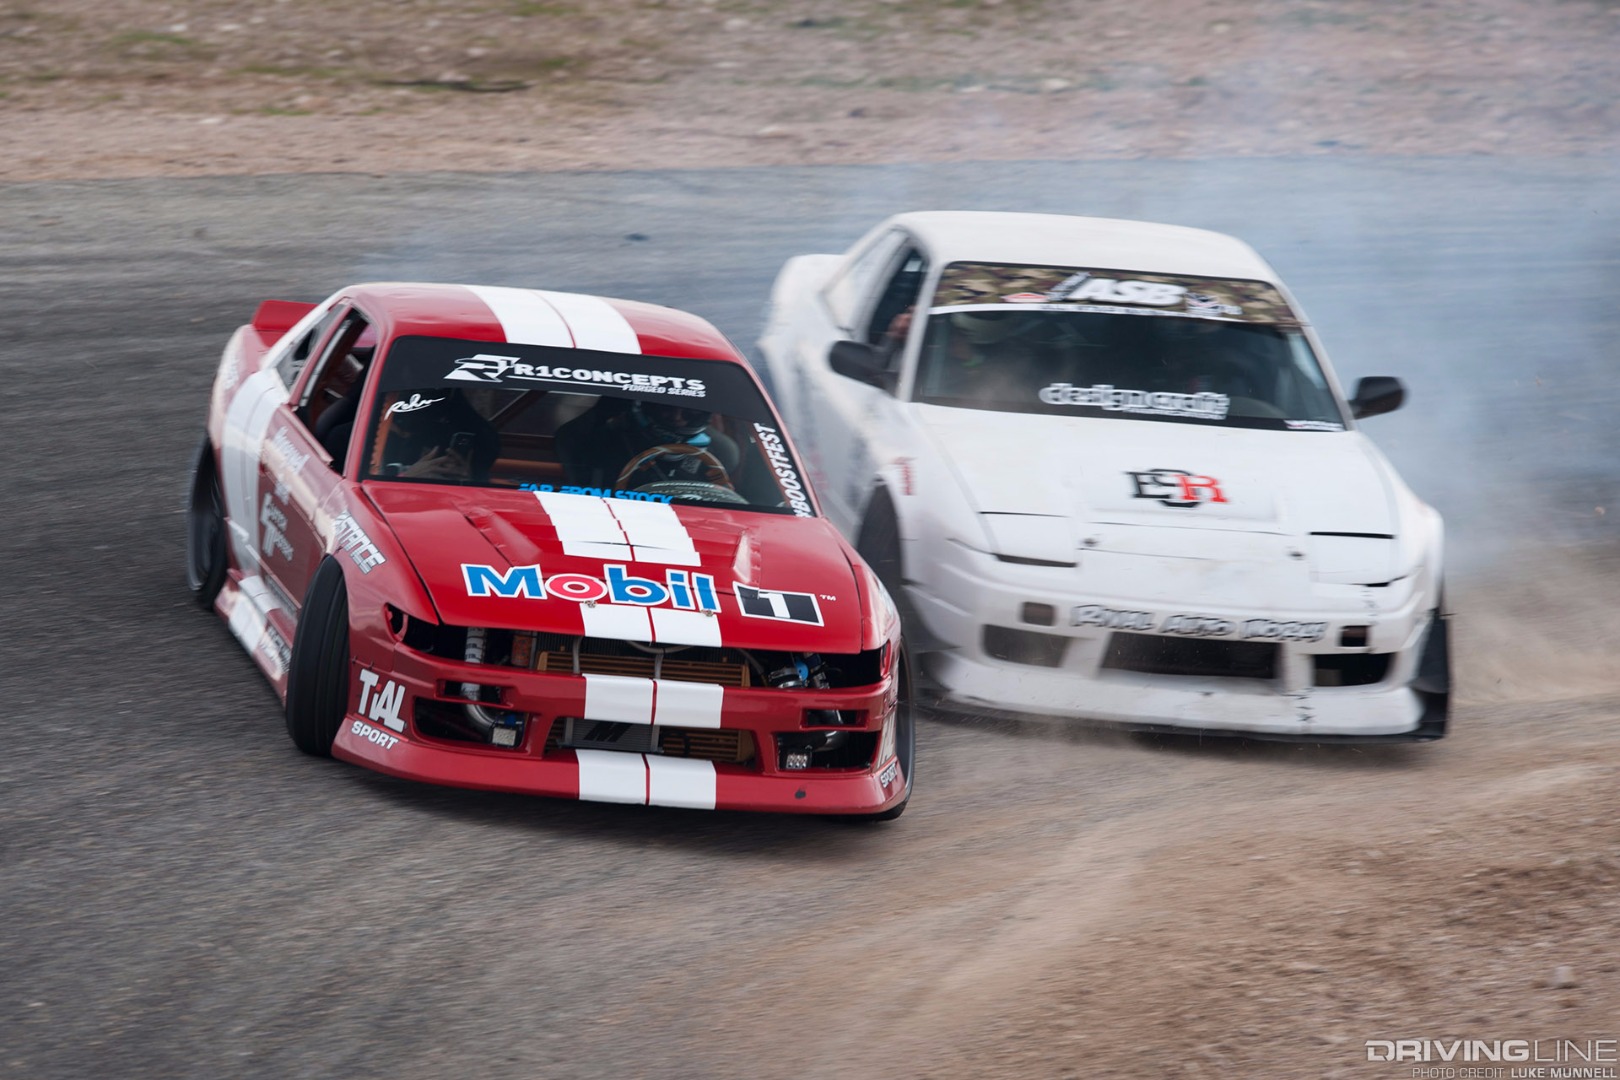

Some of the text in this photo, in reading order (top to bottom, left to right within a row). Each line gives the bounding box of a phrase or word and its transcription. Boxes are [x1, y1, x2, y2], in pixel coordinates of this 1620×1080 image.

[1067, 278, 1188, 306] ASB
[513, 363, 706, 391] R1CONCEPTS
[622, 384, 706, 398] FORGED SERIES
[615, 490, 674, 505] STOCK
[460, 563, 722, 613] Mobil
[351, 720, 399, 750] SPORT
